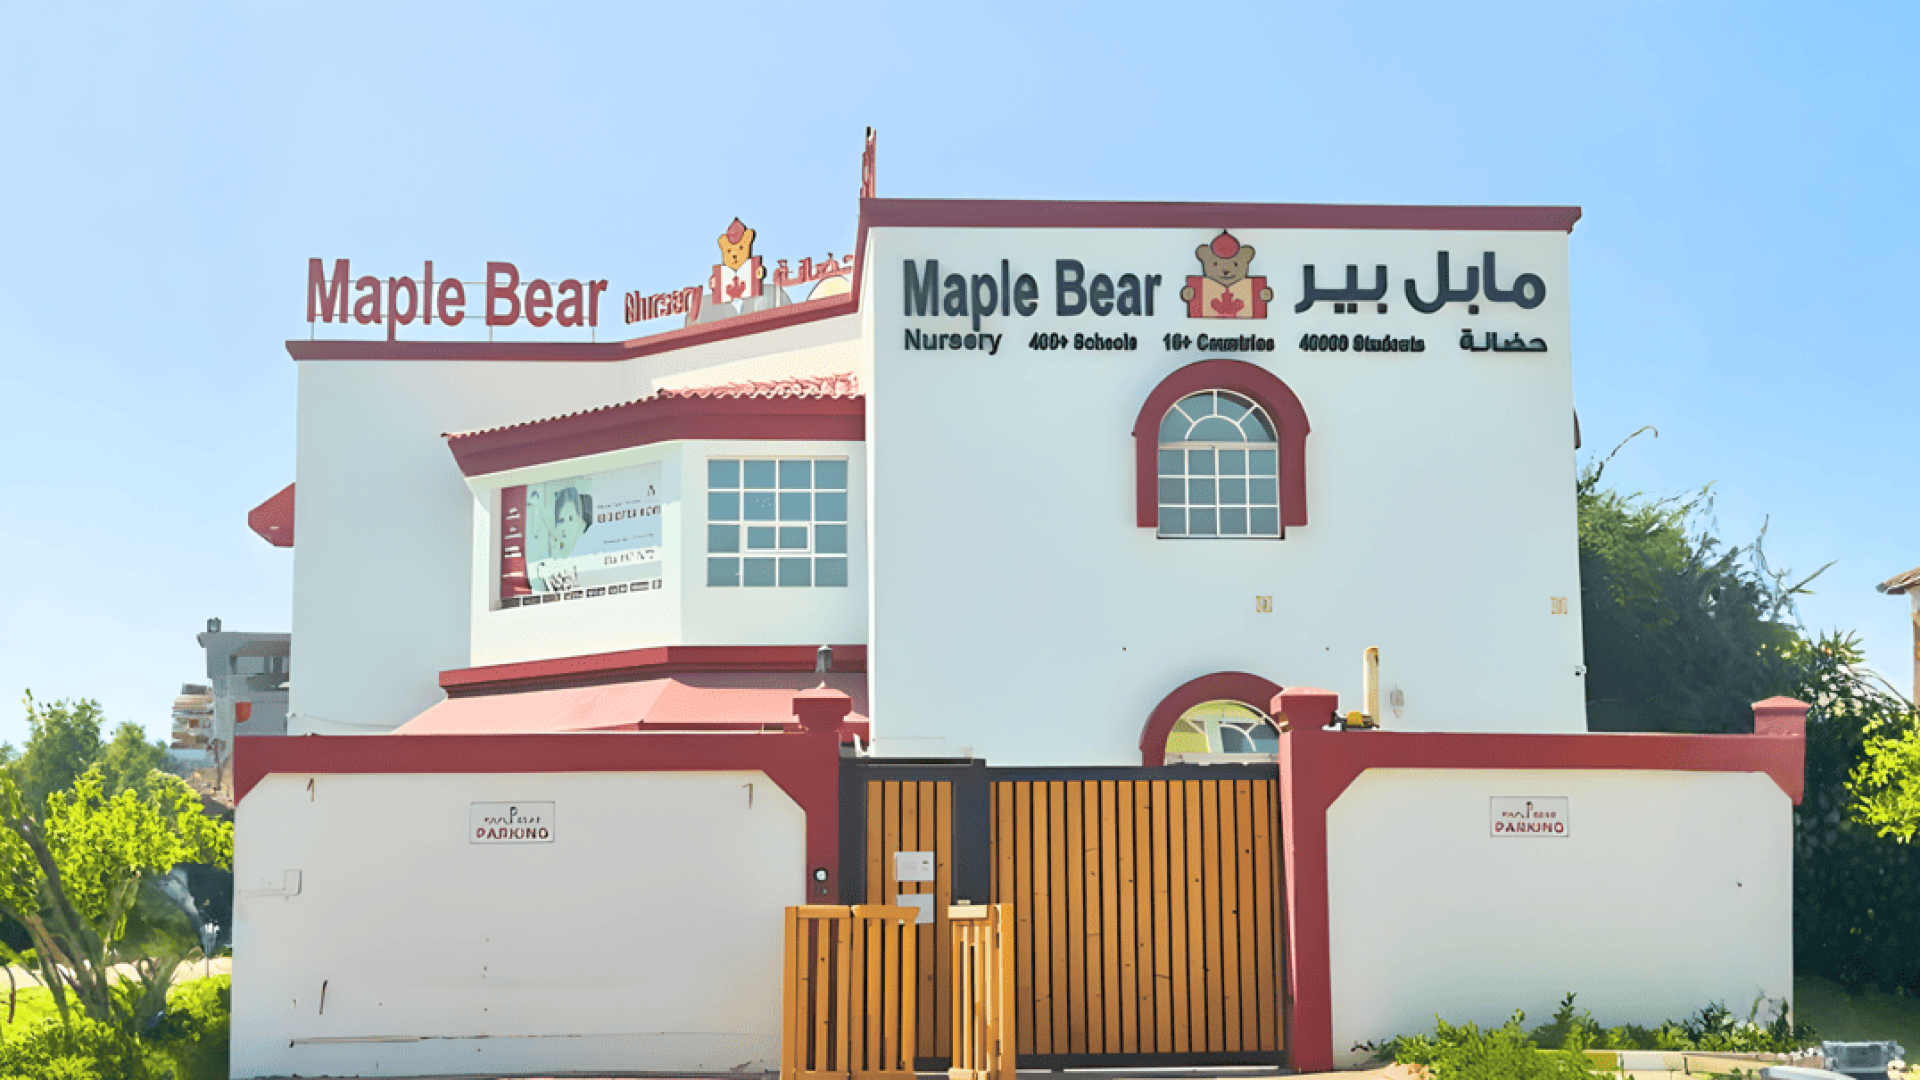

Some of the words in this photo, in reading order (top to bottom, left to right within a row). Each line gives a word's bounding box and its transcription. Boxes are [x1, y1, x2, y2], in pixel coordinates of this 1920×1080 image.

[307, 257, 466, 342] Maple
[485, 261, 608, 327] Bear
[903, 259, 1039, 332] Maple
[1055, 259, 1162, 316] Bear
[1294, 264, 1388, 314] بير
[1404, 250, 1546, 314] مابل
[904, 328, 1003, 355] Nursery
[1028, 332, 1069, 351] 400+
[1073, 332, 1137, 351] Schools
